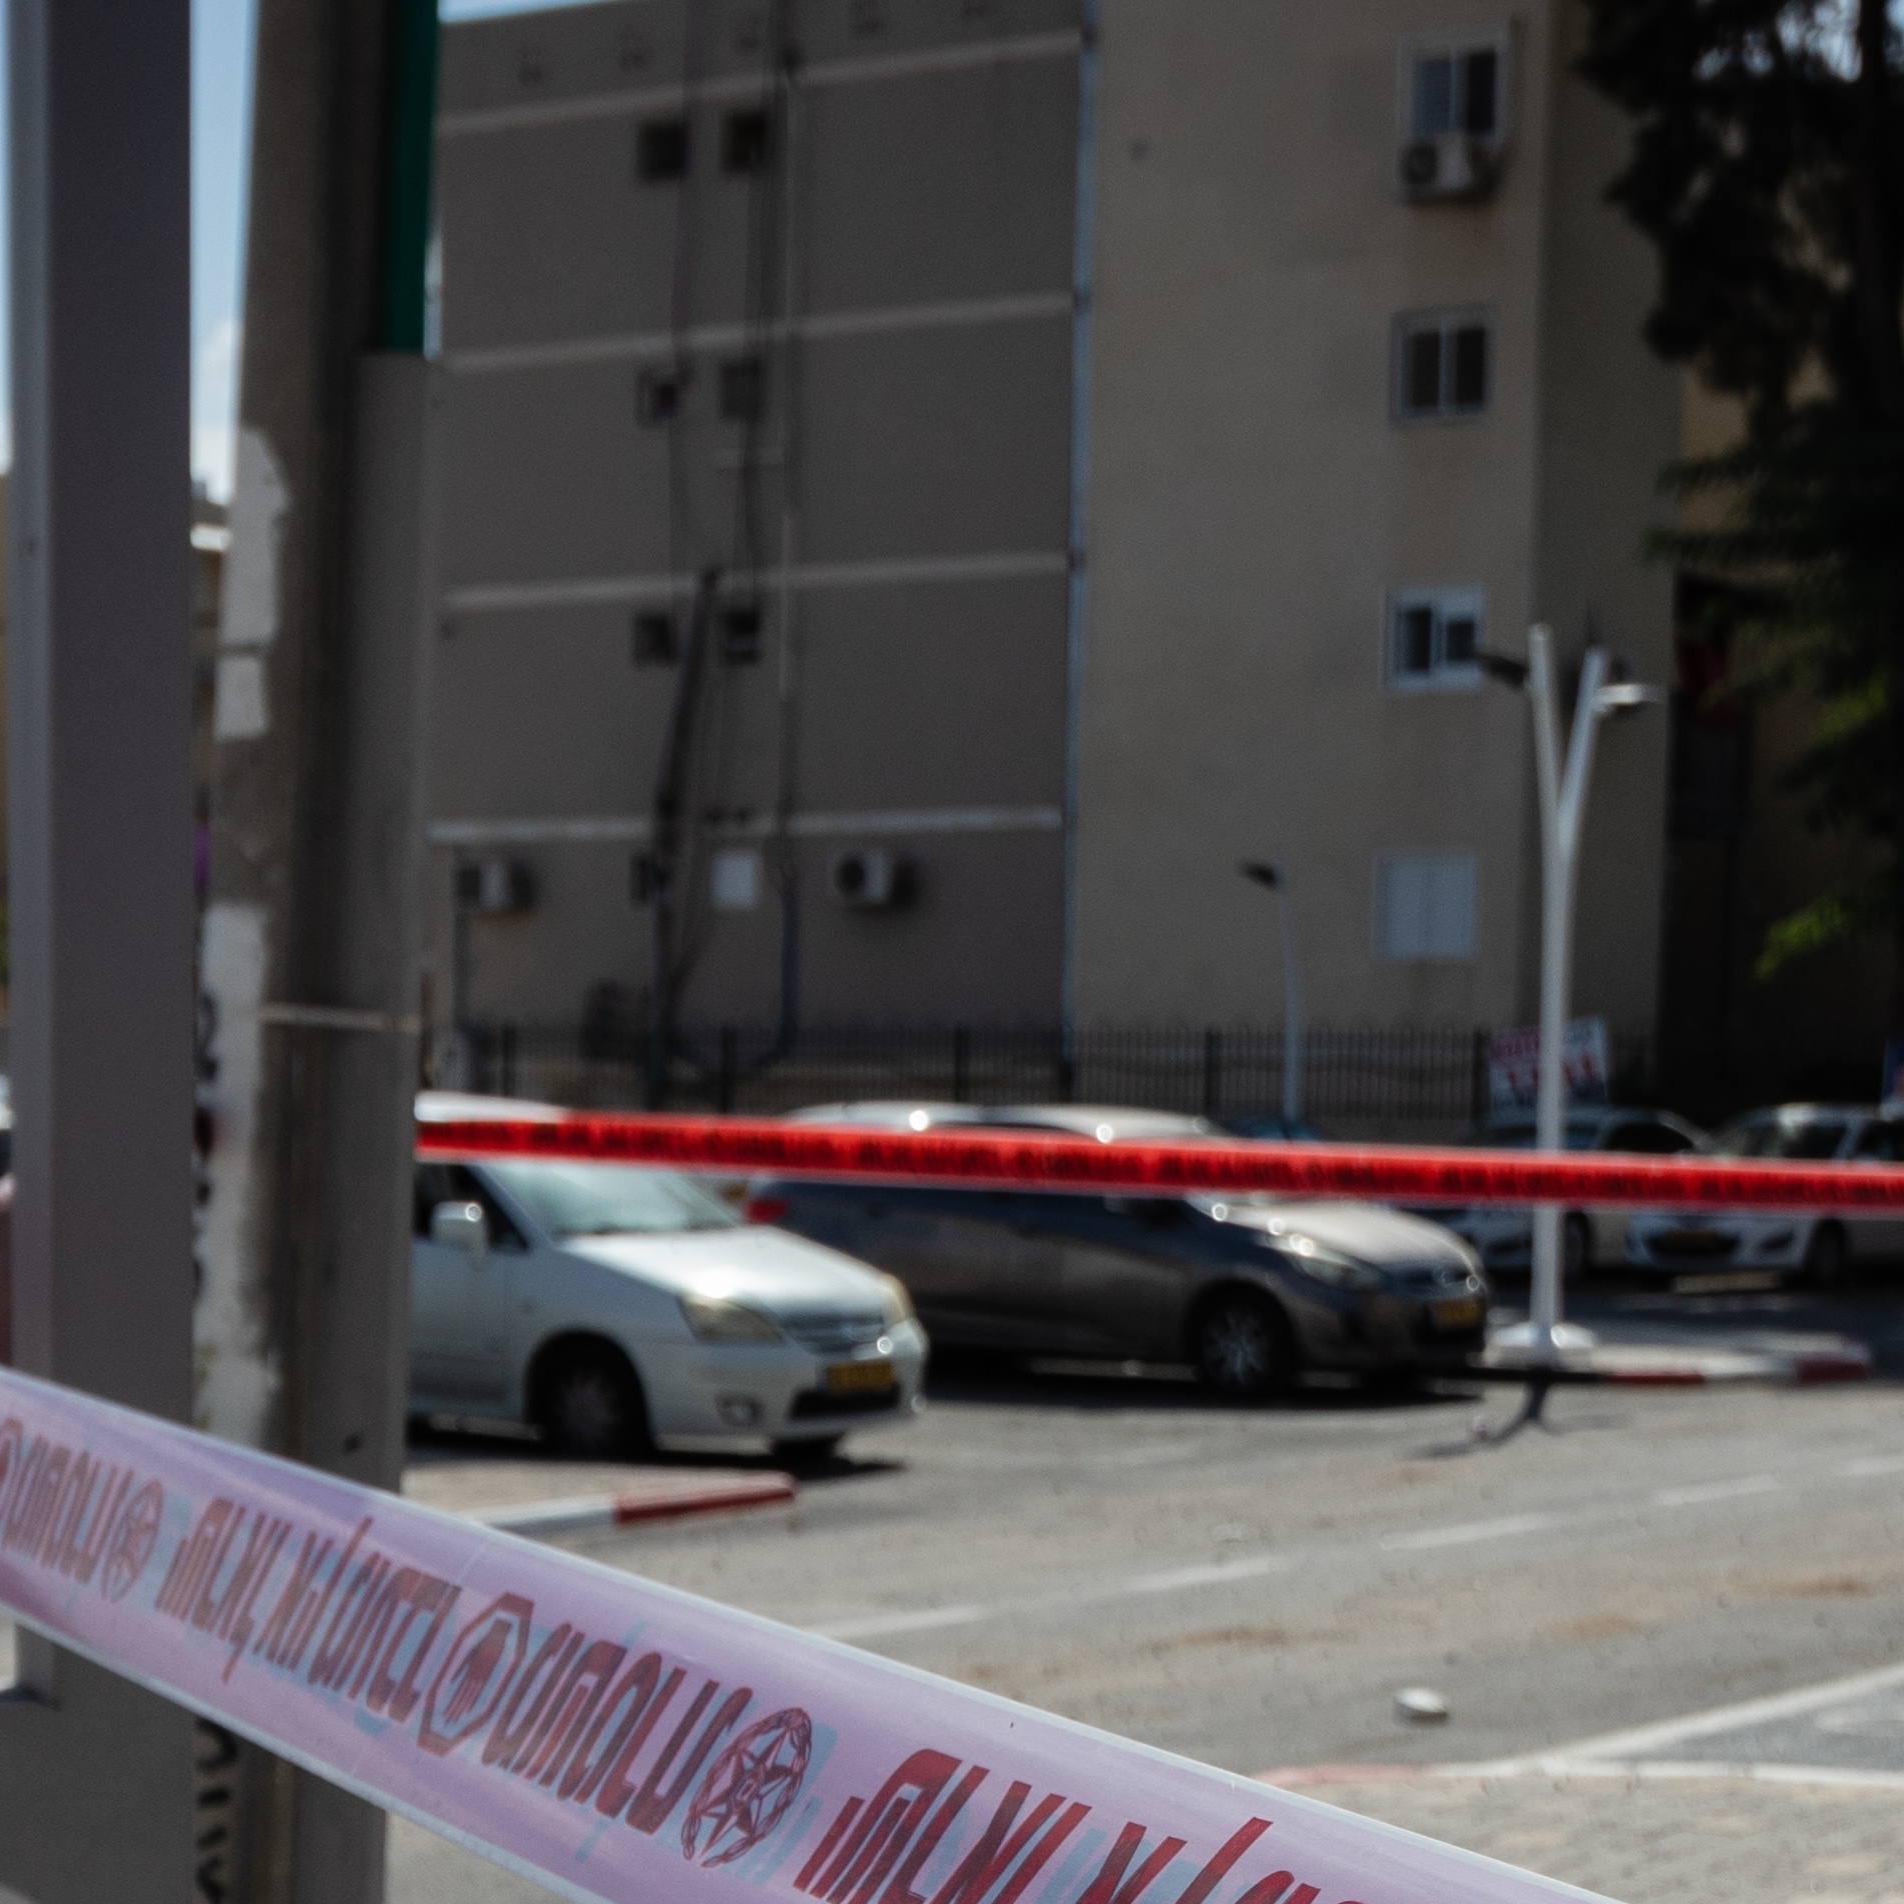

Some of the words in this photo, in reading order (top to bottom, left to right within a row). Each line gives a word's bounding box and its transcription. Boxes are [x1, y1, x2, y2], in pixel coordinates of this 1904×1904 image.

[0, 1433, 135, 1584] משטרת
[154, 1496, 293, 1684] ישראל
[252, 1515, 375, 1672] אין
[307, 1550, 463, 1724] מעבר
[481, 1621, 752, 1835] משטרת
